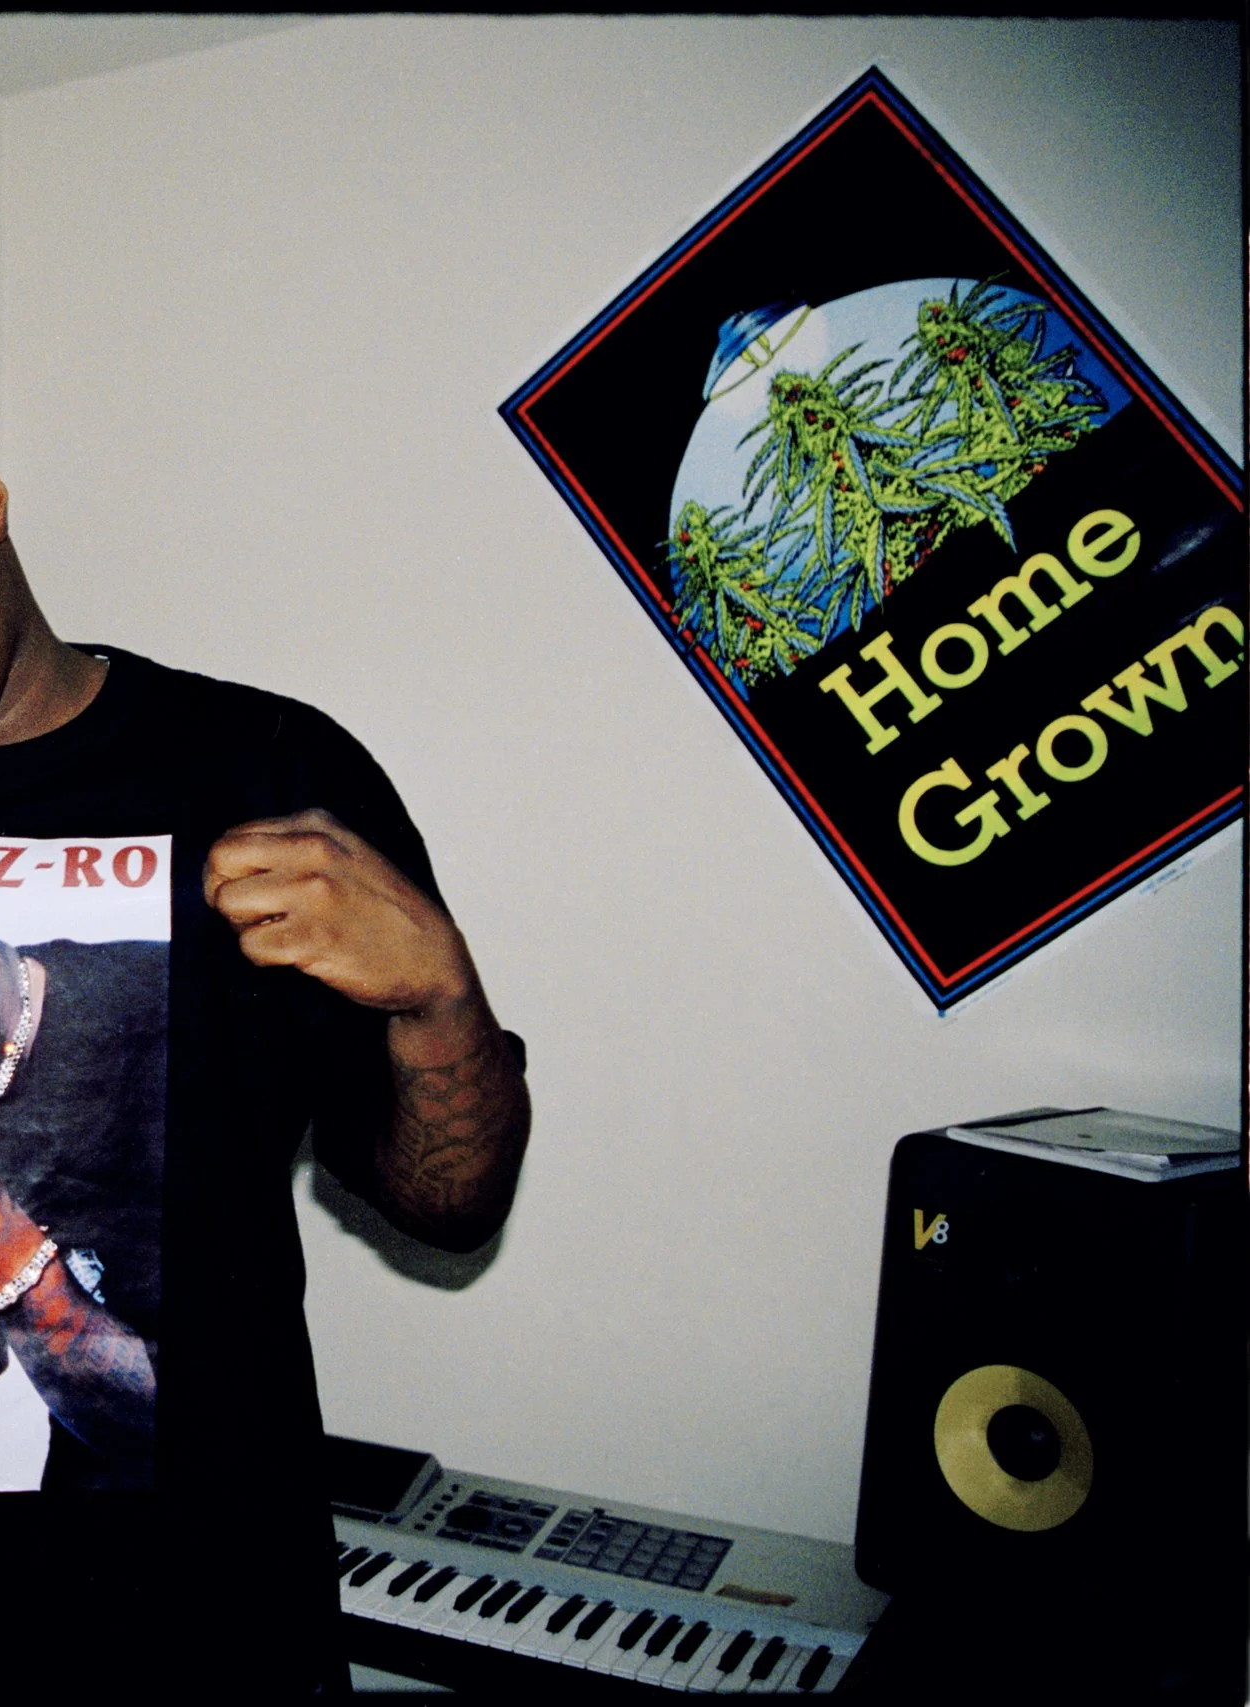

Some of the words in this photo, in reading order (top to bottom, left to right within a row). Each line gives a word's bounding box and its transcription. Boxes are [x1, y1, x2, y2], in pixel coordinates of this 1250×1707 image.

[818, 509, 1141, 755] Home
[898, 605, 1244, 866] Grown
[913, 1208, 950, 1250] V8
